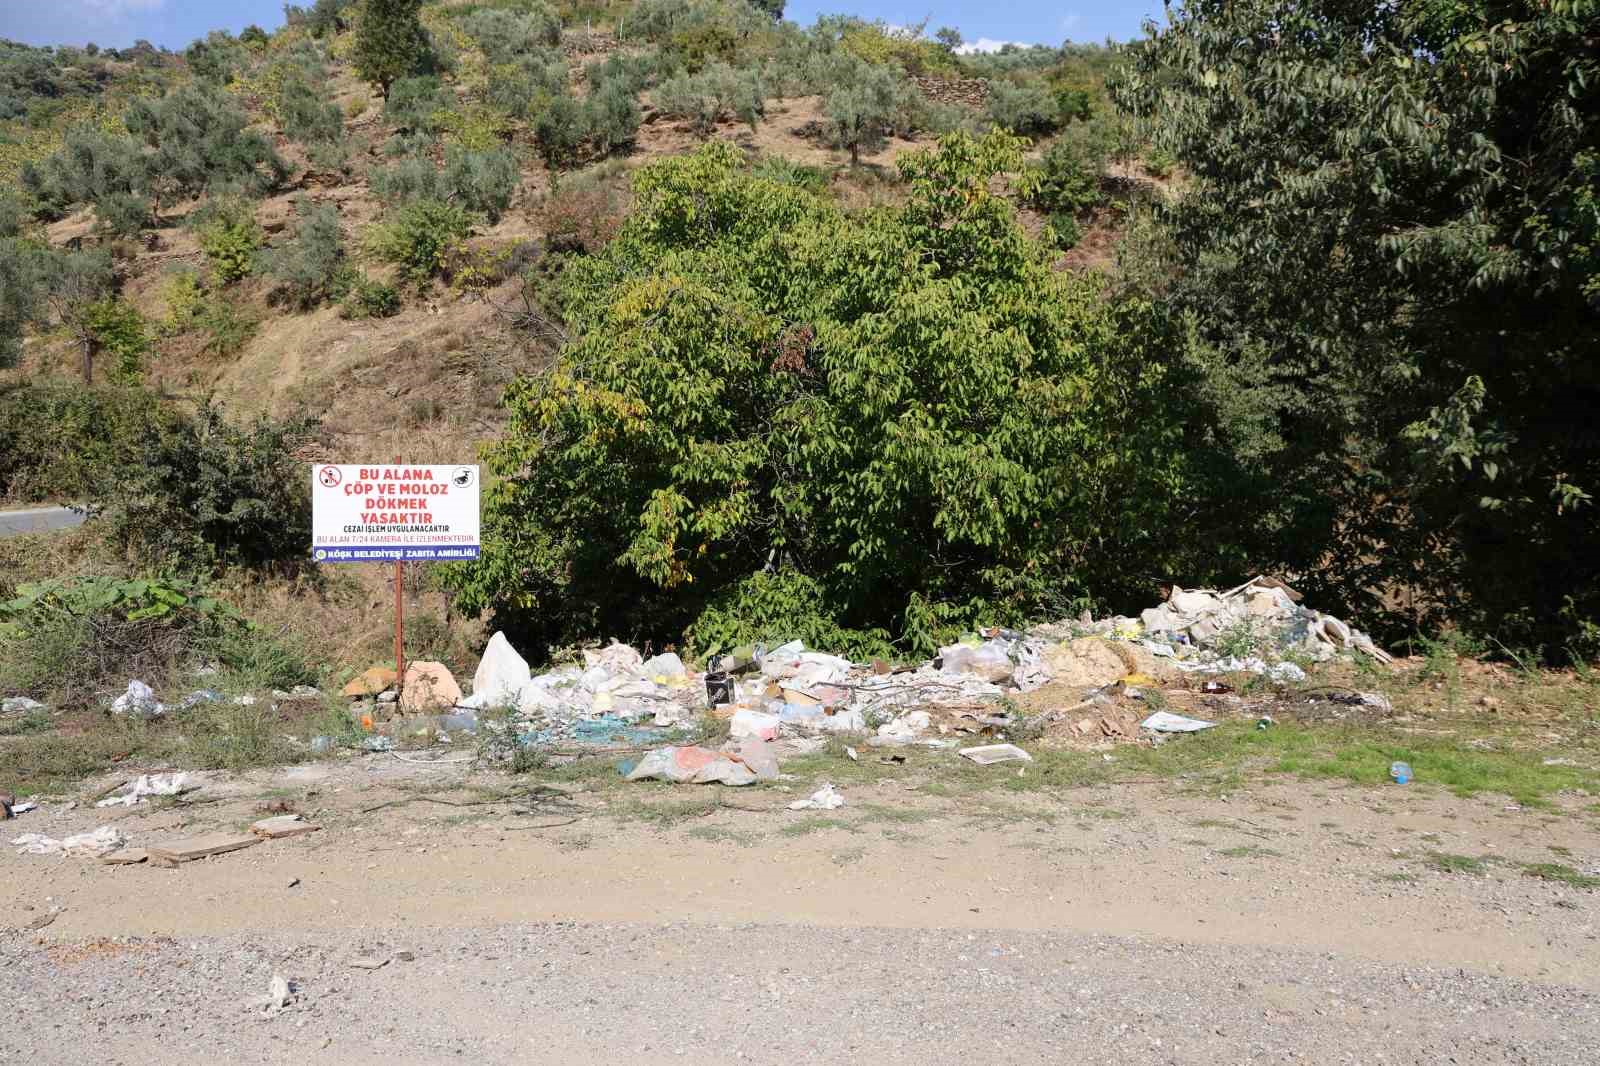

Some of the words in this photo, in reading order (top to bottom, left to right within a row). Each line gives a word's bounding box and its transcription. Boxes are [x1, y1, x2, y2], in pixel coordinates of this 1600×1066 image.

[360, 469, 379, 480] BU
[383, 469, 433, 480] ALANA
[344, 481, 373, 496] ÇÖP
[377, 483, 396, 494] VE
[400, 483, 448, 494] MOLOZ
[365, 496, 427, 509] DÖKMEK
[360, 513, 433, 524] YASAKTIR
[387, 525, 450, 533] UYGULANACAKTIR
[329, 535, 350, 543] ALAN
[370, 534, 401, 543] KAMERA
